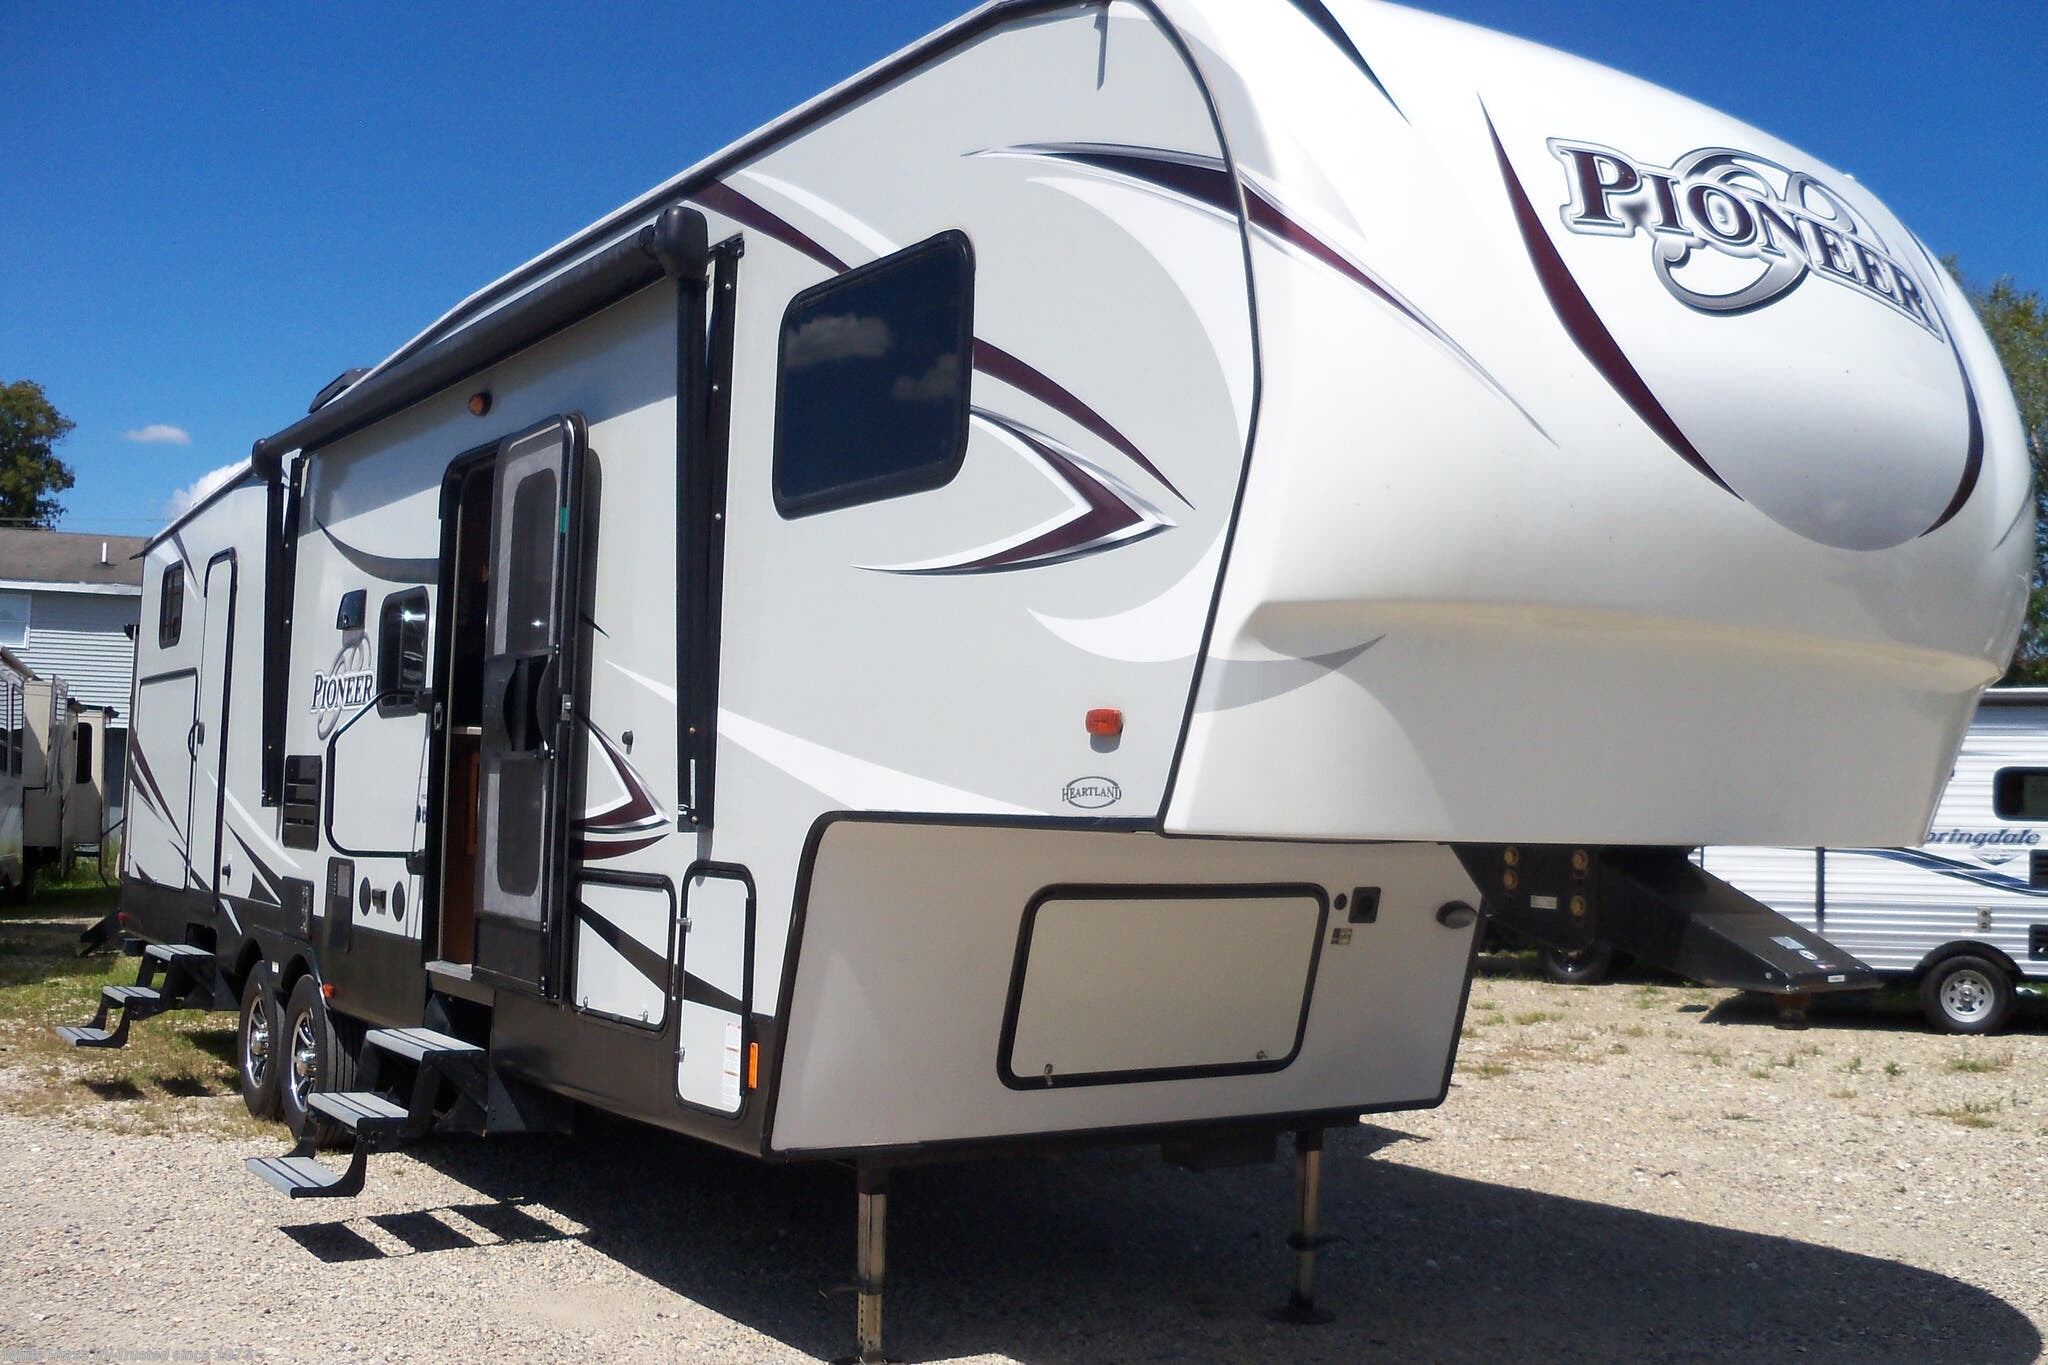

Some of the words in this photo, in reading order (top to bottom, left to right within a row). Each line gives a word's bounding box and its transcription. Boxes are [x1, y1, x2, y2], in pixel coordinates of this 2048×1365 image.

[1552, 142, 1942, 340] PIONEER
[311, 673, 374, 710] PIONEER
[1061, 785, 1122, 802] HEARTLAND
[1926, 829, 2041, 849] pringdale
